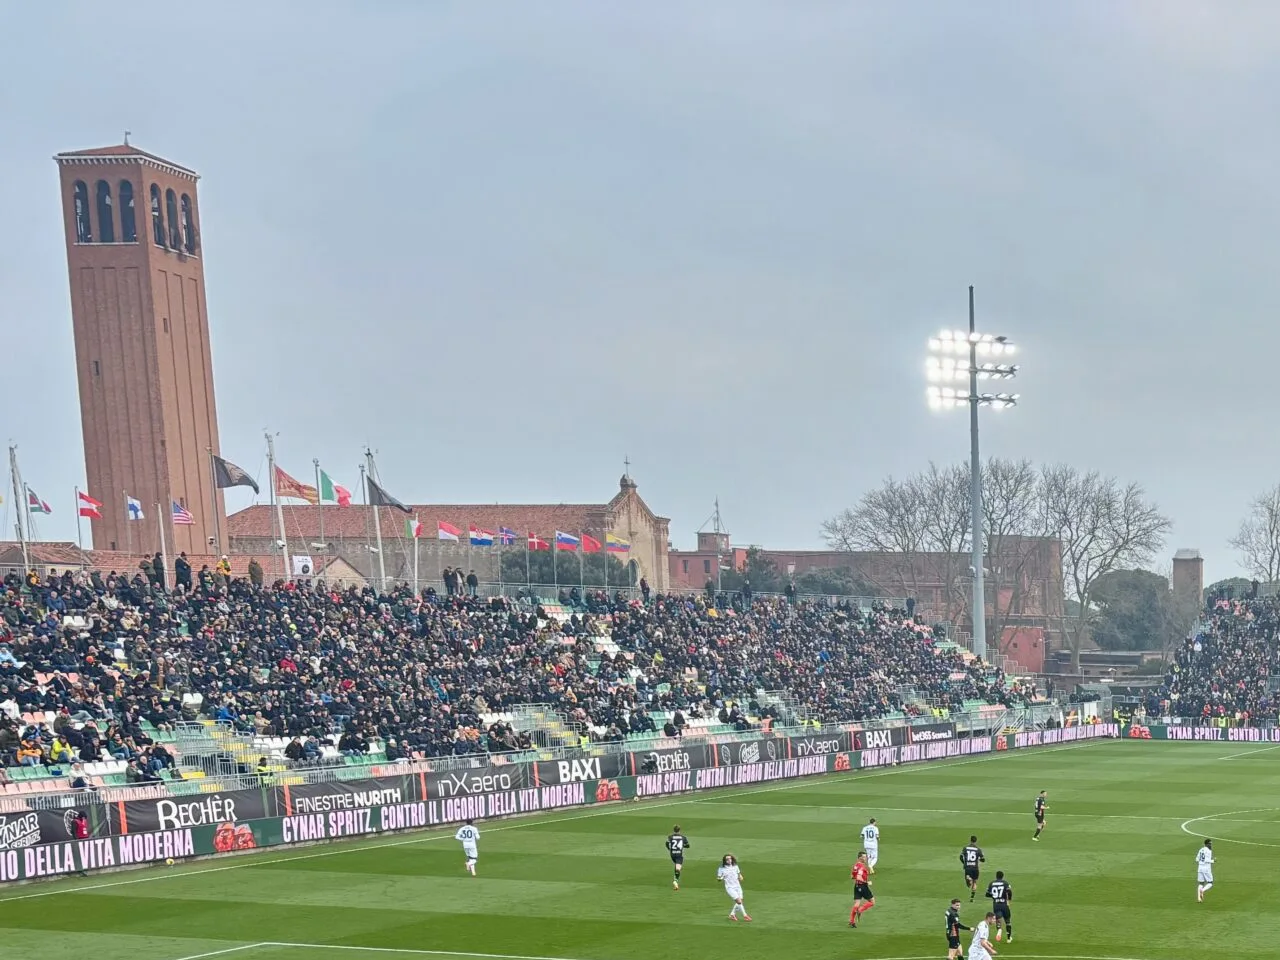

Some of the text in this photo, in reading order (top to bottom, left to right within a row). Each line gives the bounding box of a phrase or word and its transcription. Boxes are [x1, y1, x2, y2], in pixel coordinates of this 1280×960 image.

[865, 730, 891, 748] BAXI
[1167, 726, 1192, 740] CYNAR
[1228, 728, 1259, 741] CONTRO
[1261, 728, 1269, 742] IL
[558, 757, 601, 782] BAXI
[637, 773, 662, 796] CYNAR
[696, 767, 724, 788] CONTRO
[726, 765, 733, 785] IL
[734, 762, 762, 784] LOGORIO
[764, 760, 782, 781] DELLA
[784, 758, 797, 778] VITA
[800, 755, 827, 776] MODERNA
[295, 787, 401, 813] FINESTRE NURITH
[282, 812, 325, 842] CYNAR
[381, 801, 426, 830] CONTRO
[428, 799, 439, 824] IL
[441, 795, 485, 823] LOGORIO
[488, 789, 517, 816] DELLA
[520, 786, 540, 811] VITA
[542, 782, 585, 808] MODERNA
[461, 829, 473, 839] 30
[865, 830, 875, 839] 10
[23, 843, 74, 878] DELLA
[78, 837, 115, 871] VITA
[118, 828, 194, 866] MODERNA
[671, 839, 684, 850] 24
[966, 850, 977, 862] 16
[991, 886, 1005, 898] 97
